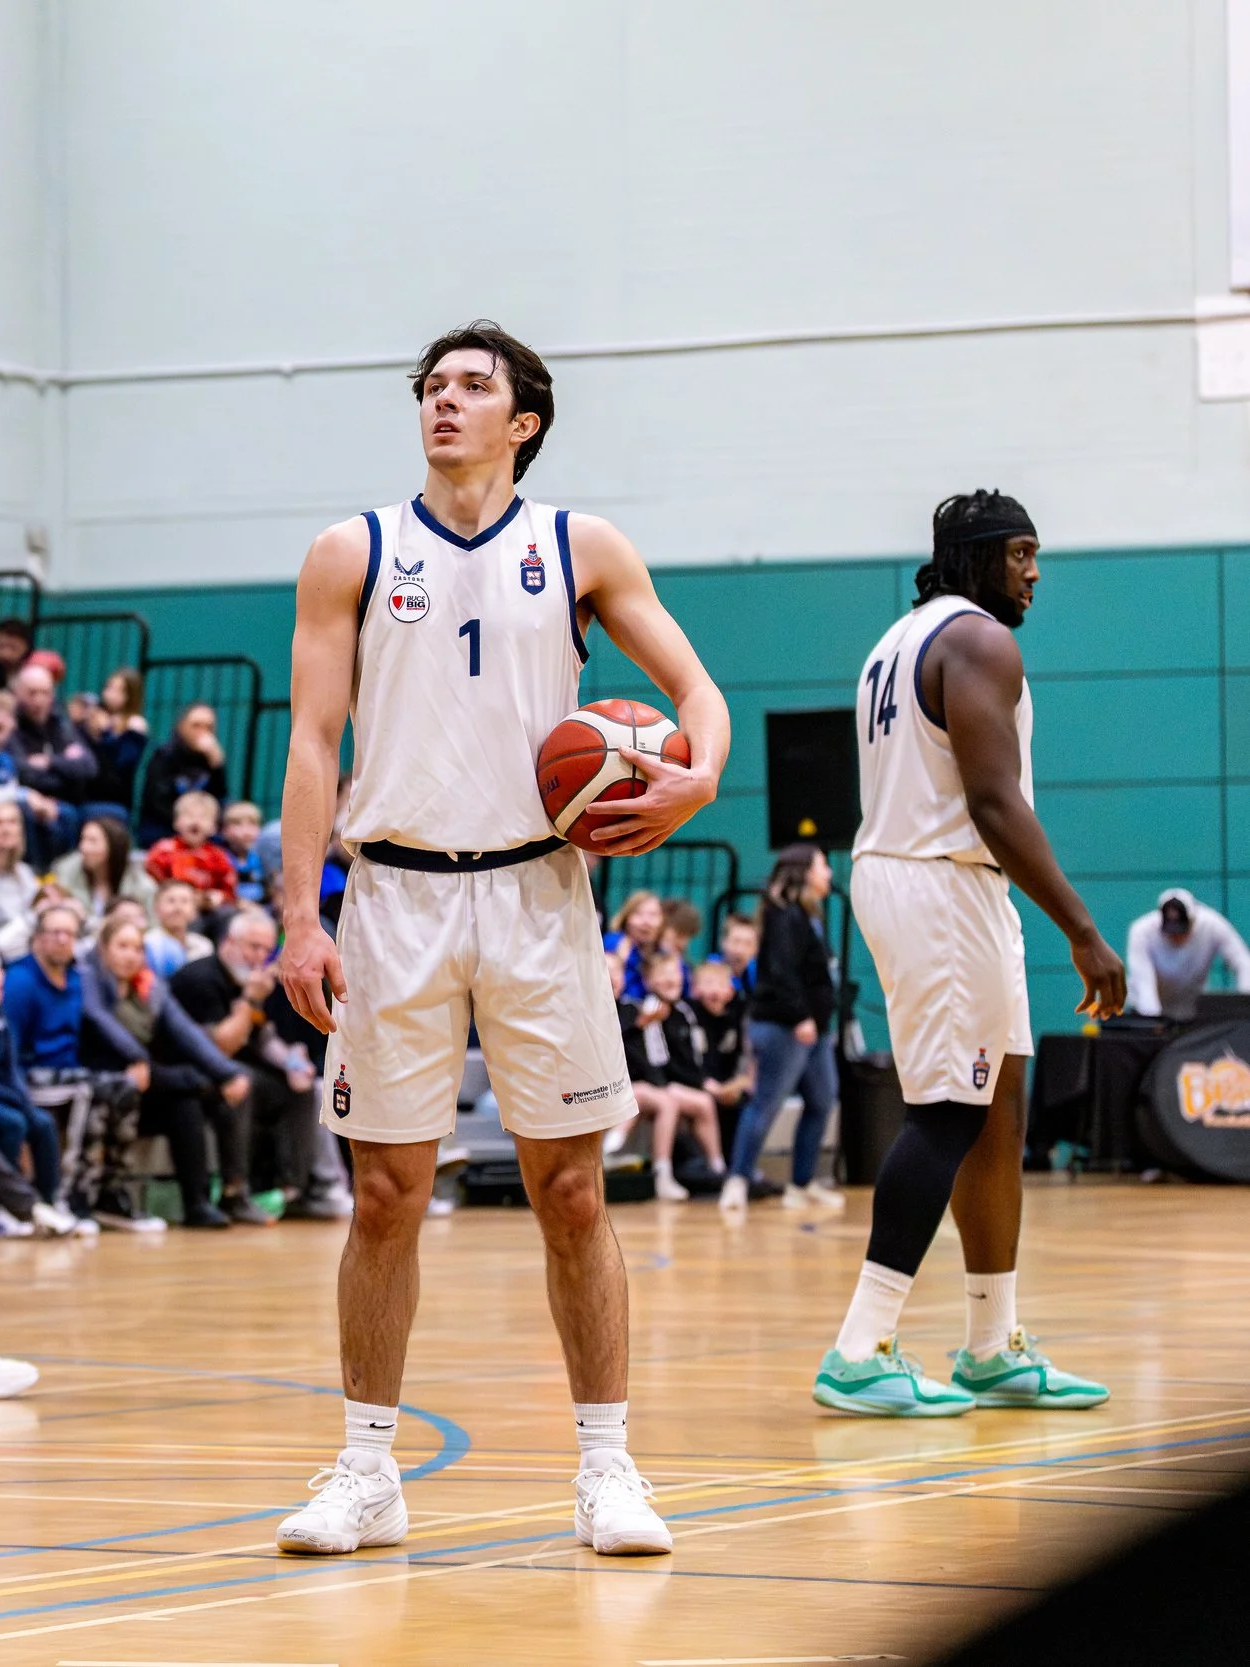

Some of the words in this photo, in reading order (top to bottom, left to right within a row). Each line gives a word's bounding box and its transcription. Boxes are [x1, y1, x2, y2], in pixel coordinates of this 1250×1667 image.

[459, 618, 480, 677] 1
[866, 651, 900, 744] 14
[573, 1085, 609, 1098] Newcastle
[574, 1092, 610, 1104] University
